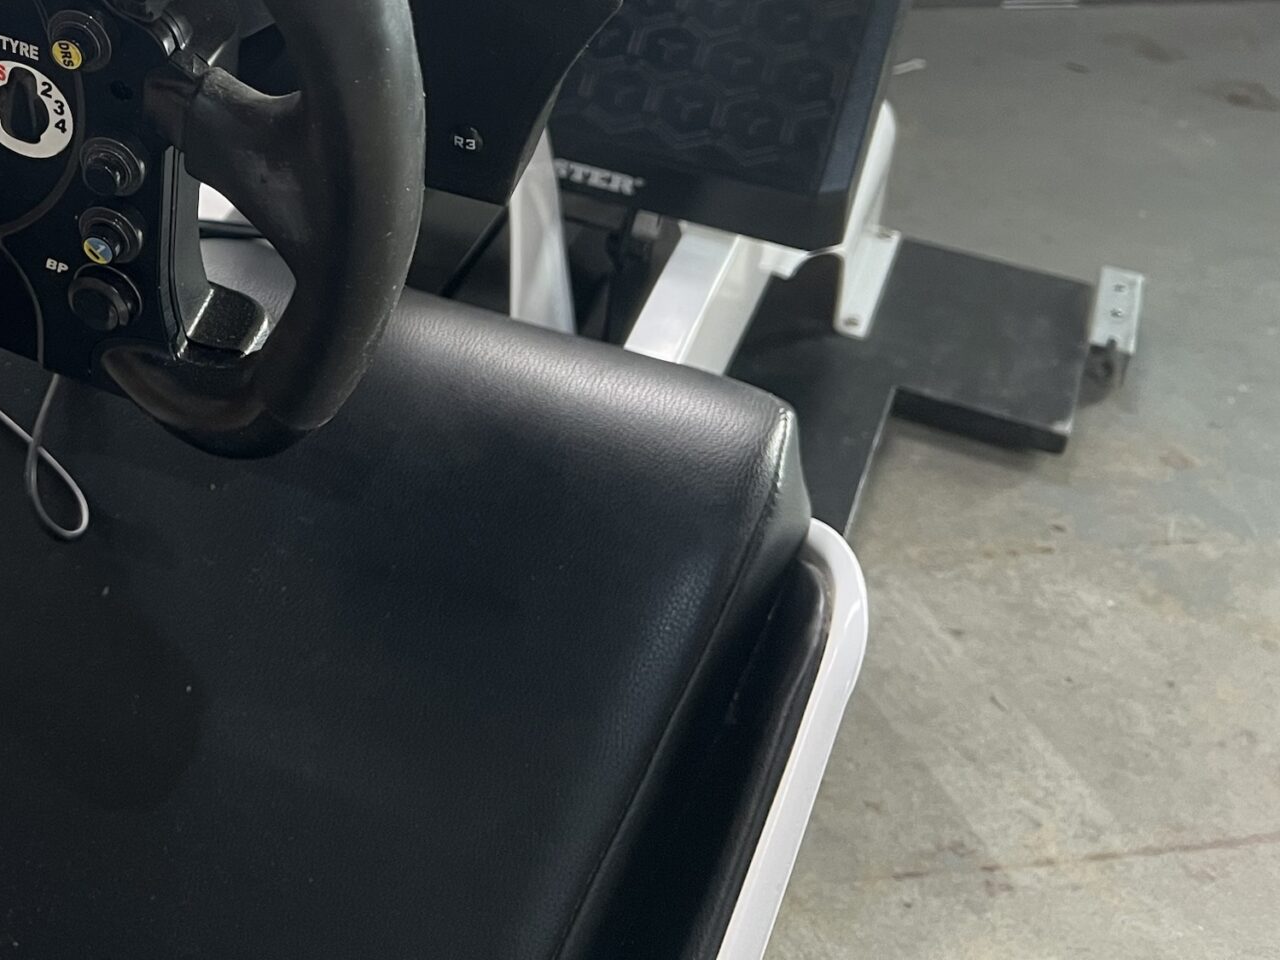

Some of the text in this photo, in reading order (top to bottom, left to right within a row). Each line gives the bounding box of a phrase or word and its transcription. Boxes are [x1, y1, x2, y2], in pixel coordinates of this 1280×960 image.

[0, 35, 39, 61] TYRE
[58, 42, 74, 67] DRS
[40, 81, 53, 99] 2
[53, 100, 65, 116] 3
[54, 118, 67, 134] 4
[454, 136, 476, 150] R3
[46, 258, 69, 273] BP
